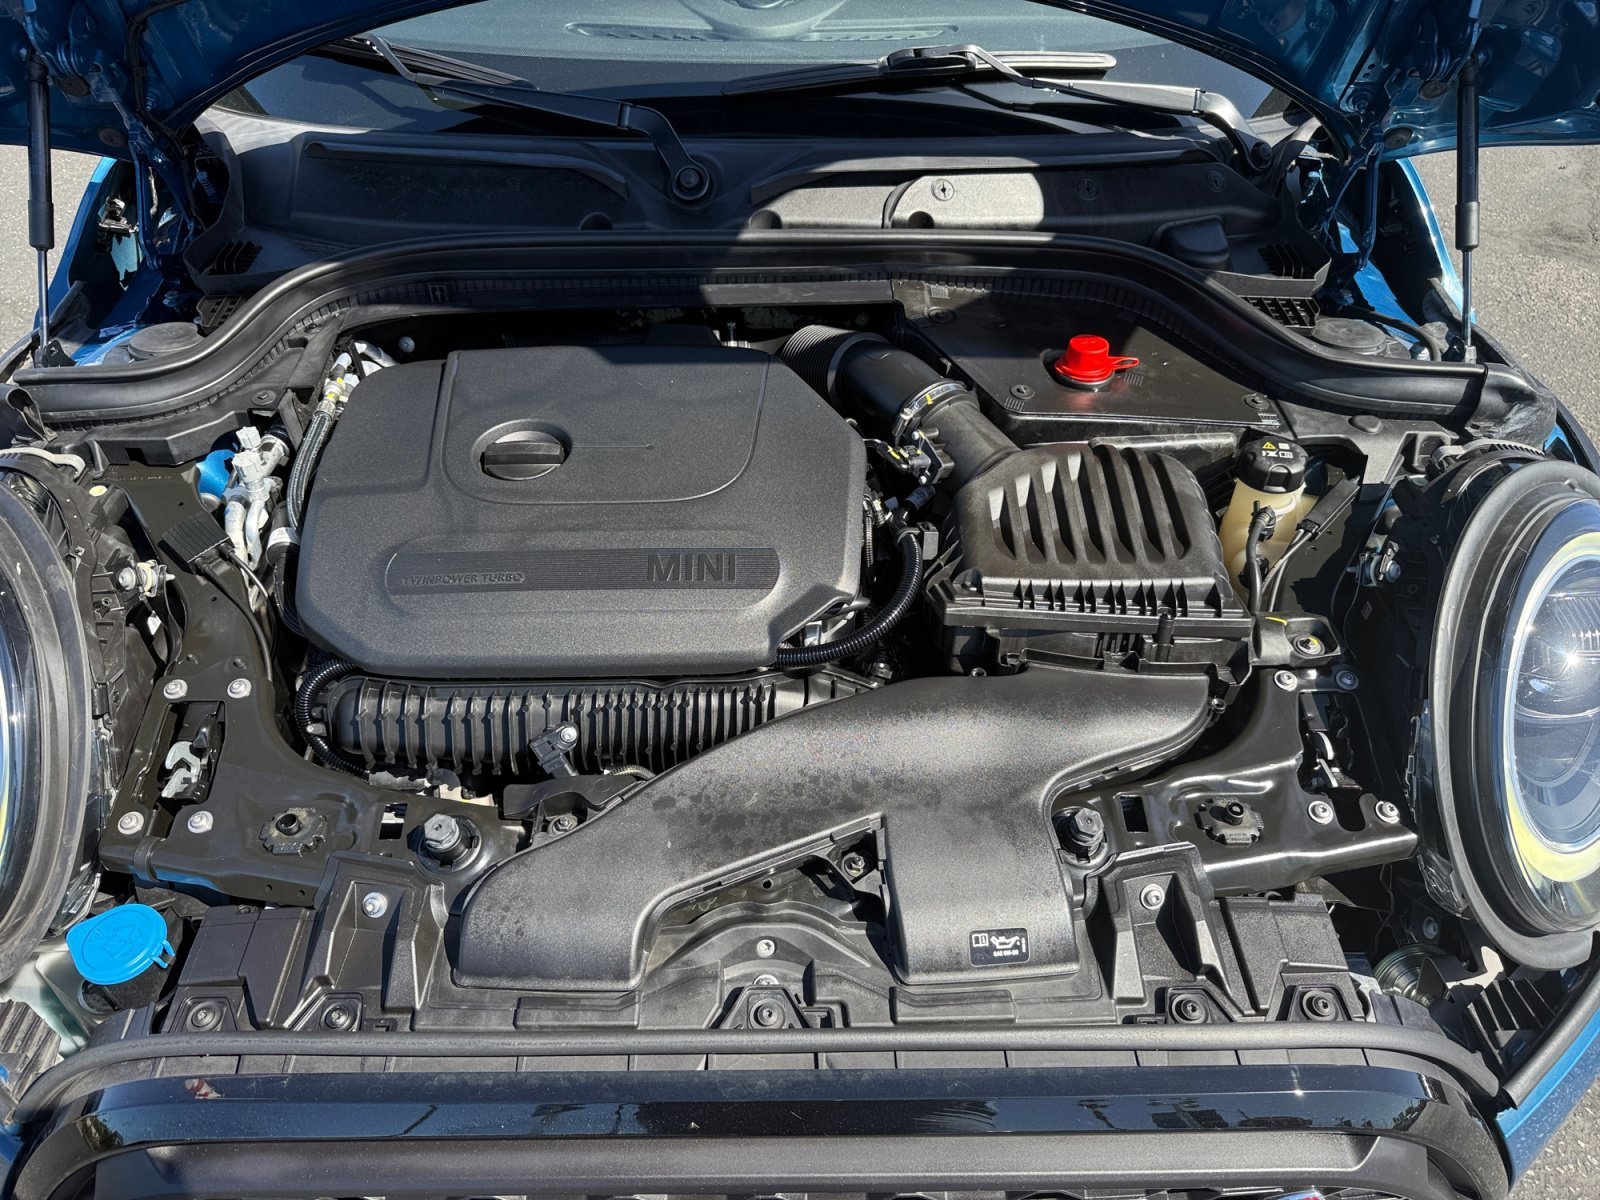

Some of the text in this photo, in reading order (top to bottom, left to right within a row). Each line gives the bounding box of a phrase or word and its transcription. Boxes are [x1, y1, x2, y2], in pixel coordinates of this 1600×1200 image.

[648, 553, 736, 582] MINI
[403, 572, 523, 585] TWINPOWER TURBO
